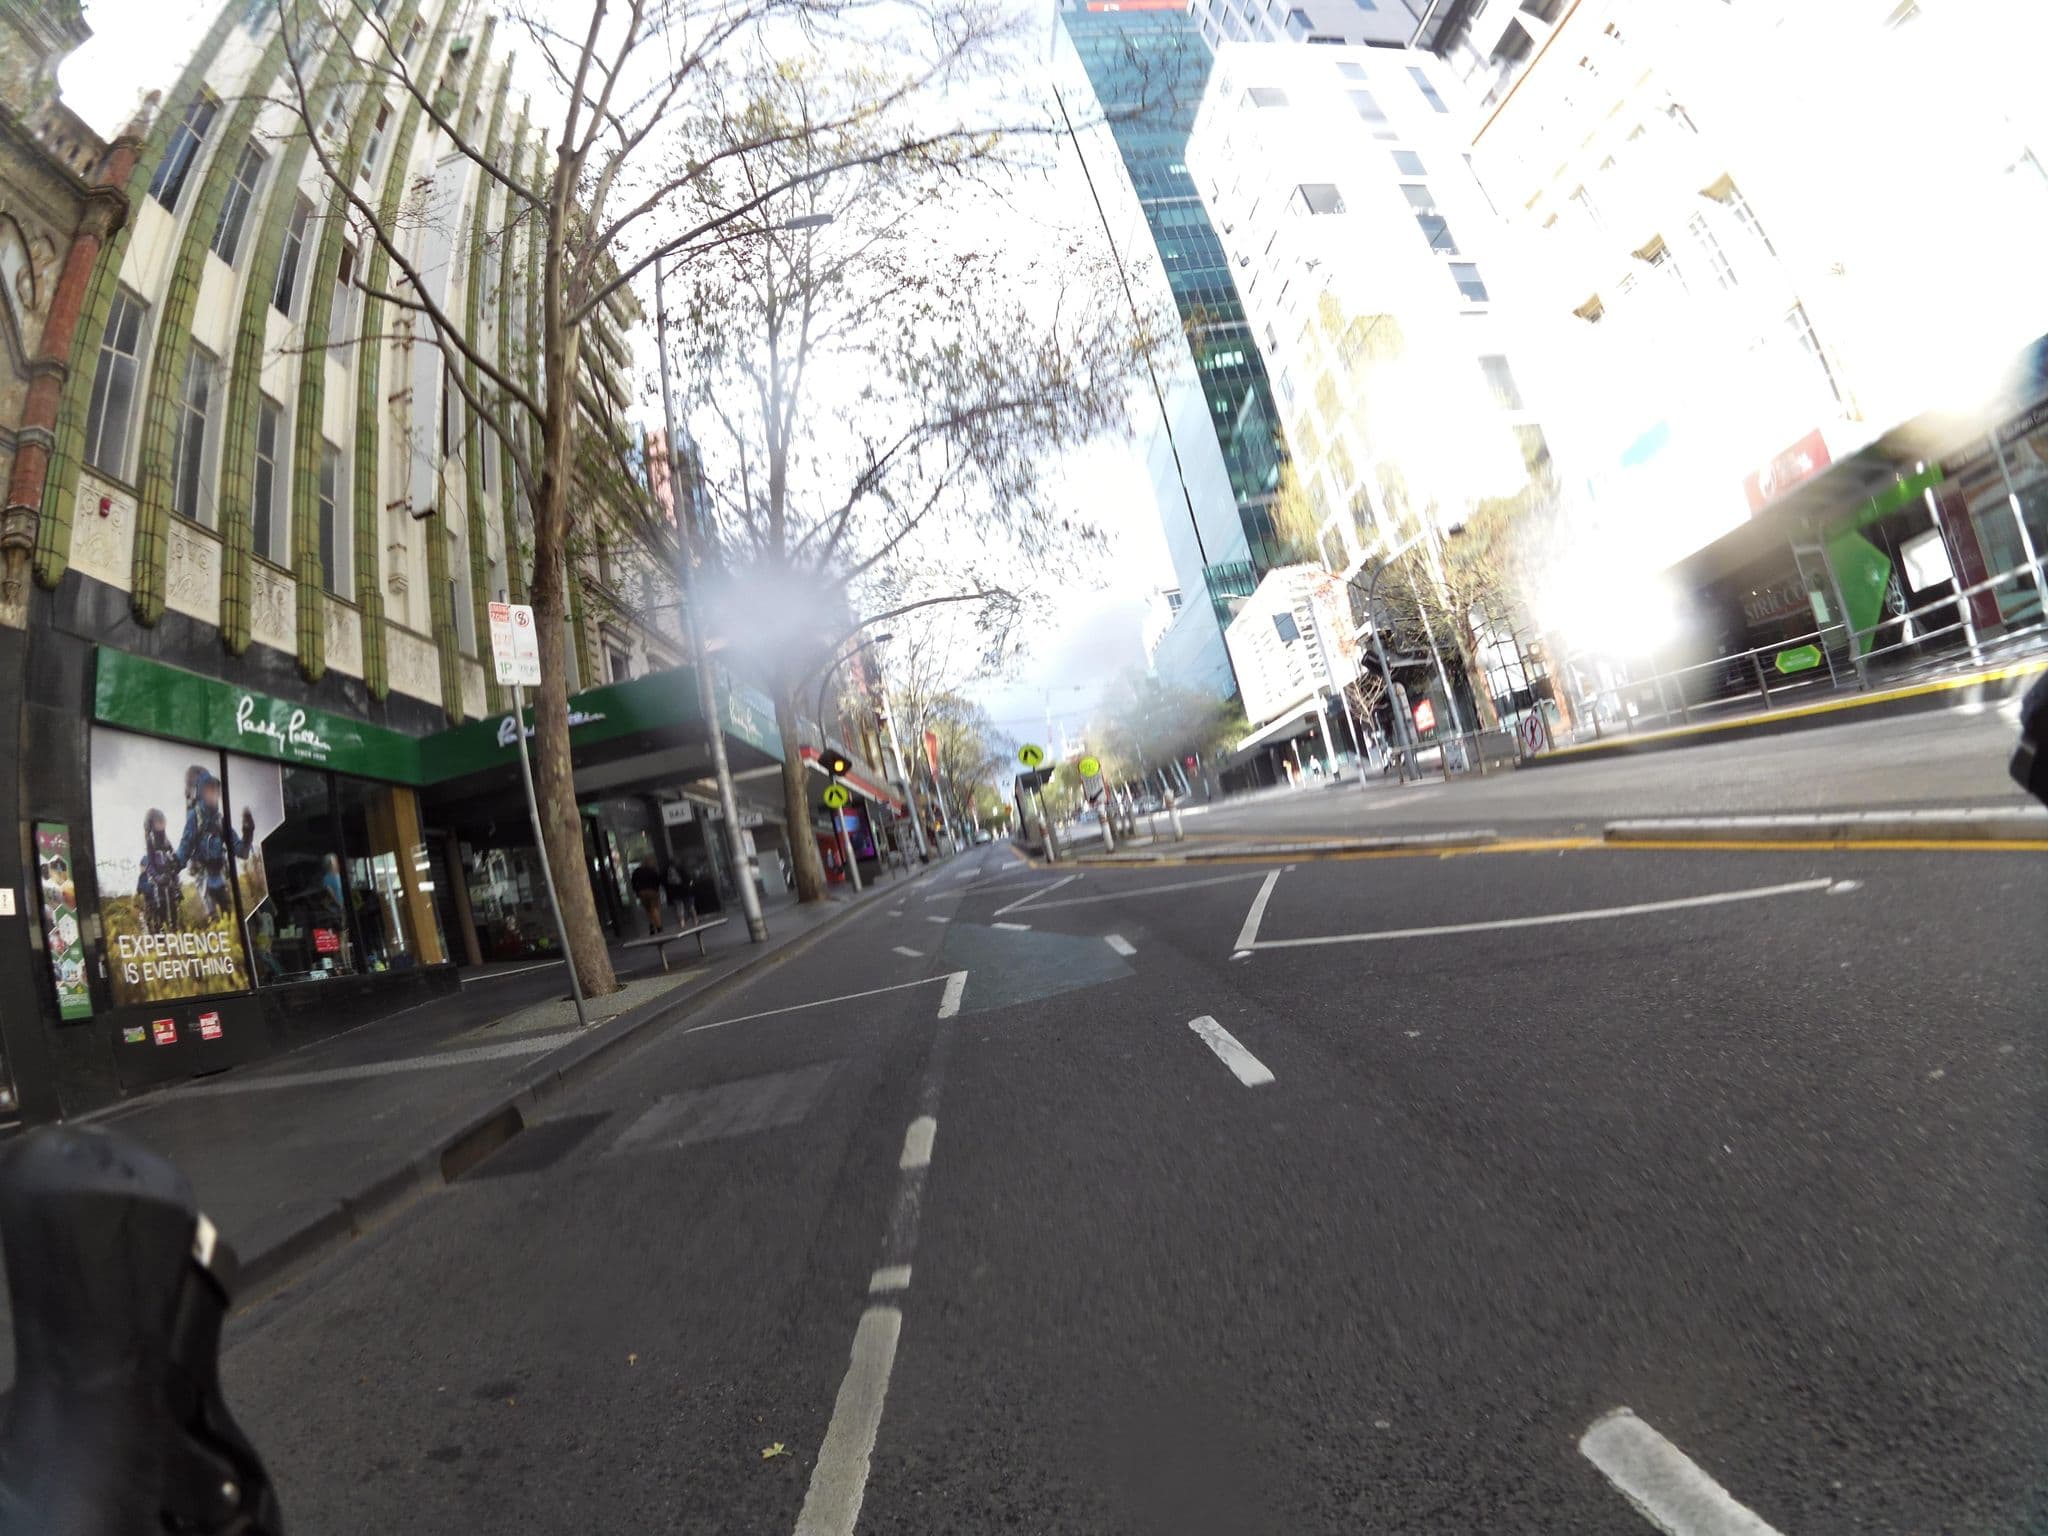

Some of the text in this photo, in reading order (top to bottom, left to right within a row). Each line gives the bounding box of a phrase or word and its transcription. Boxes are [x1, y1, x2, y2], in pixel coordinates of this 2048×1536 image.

[236, 695, 331, 754] Paddy Pallin
[118, 931, 232, 959] EXPERIENCE
[124, 956, 235, 985] IS EVERYTHING
